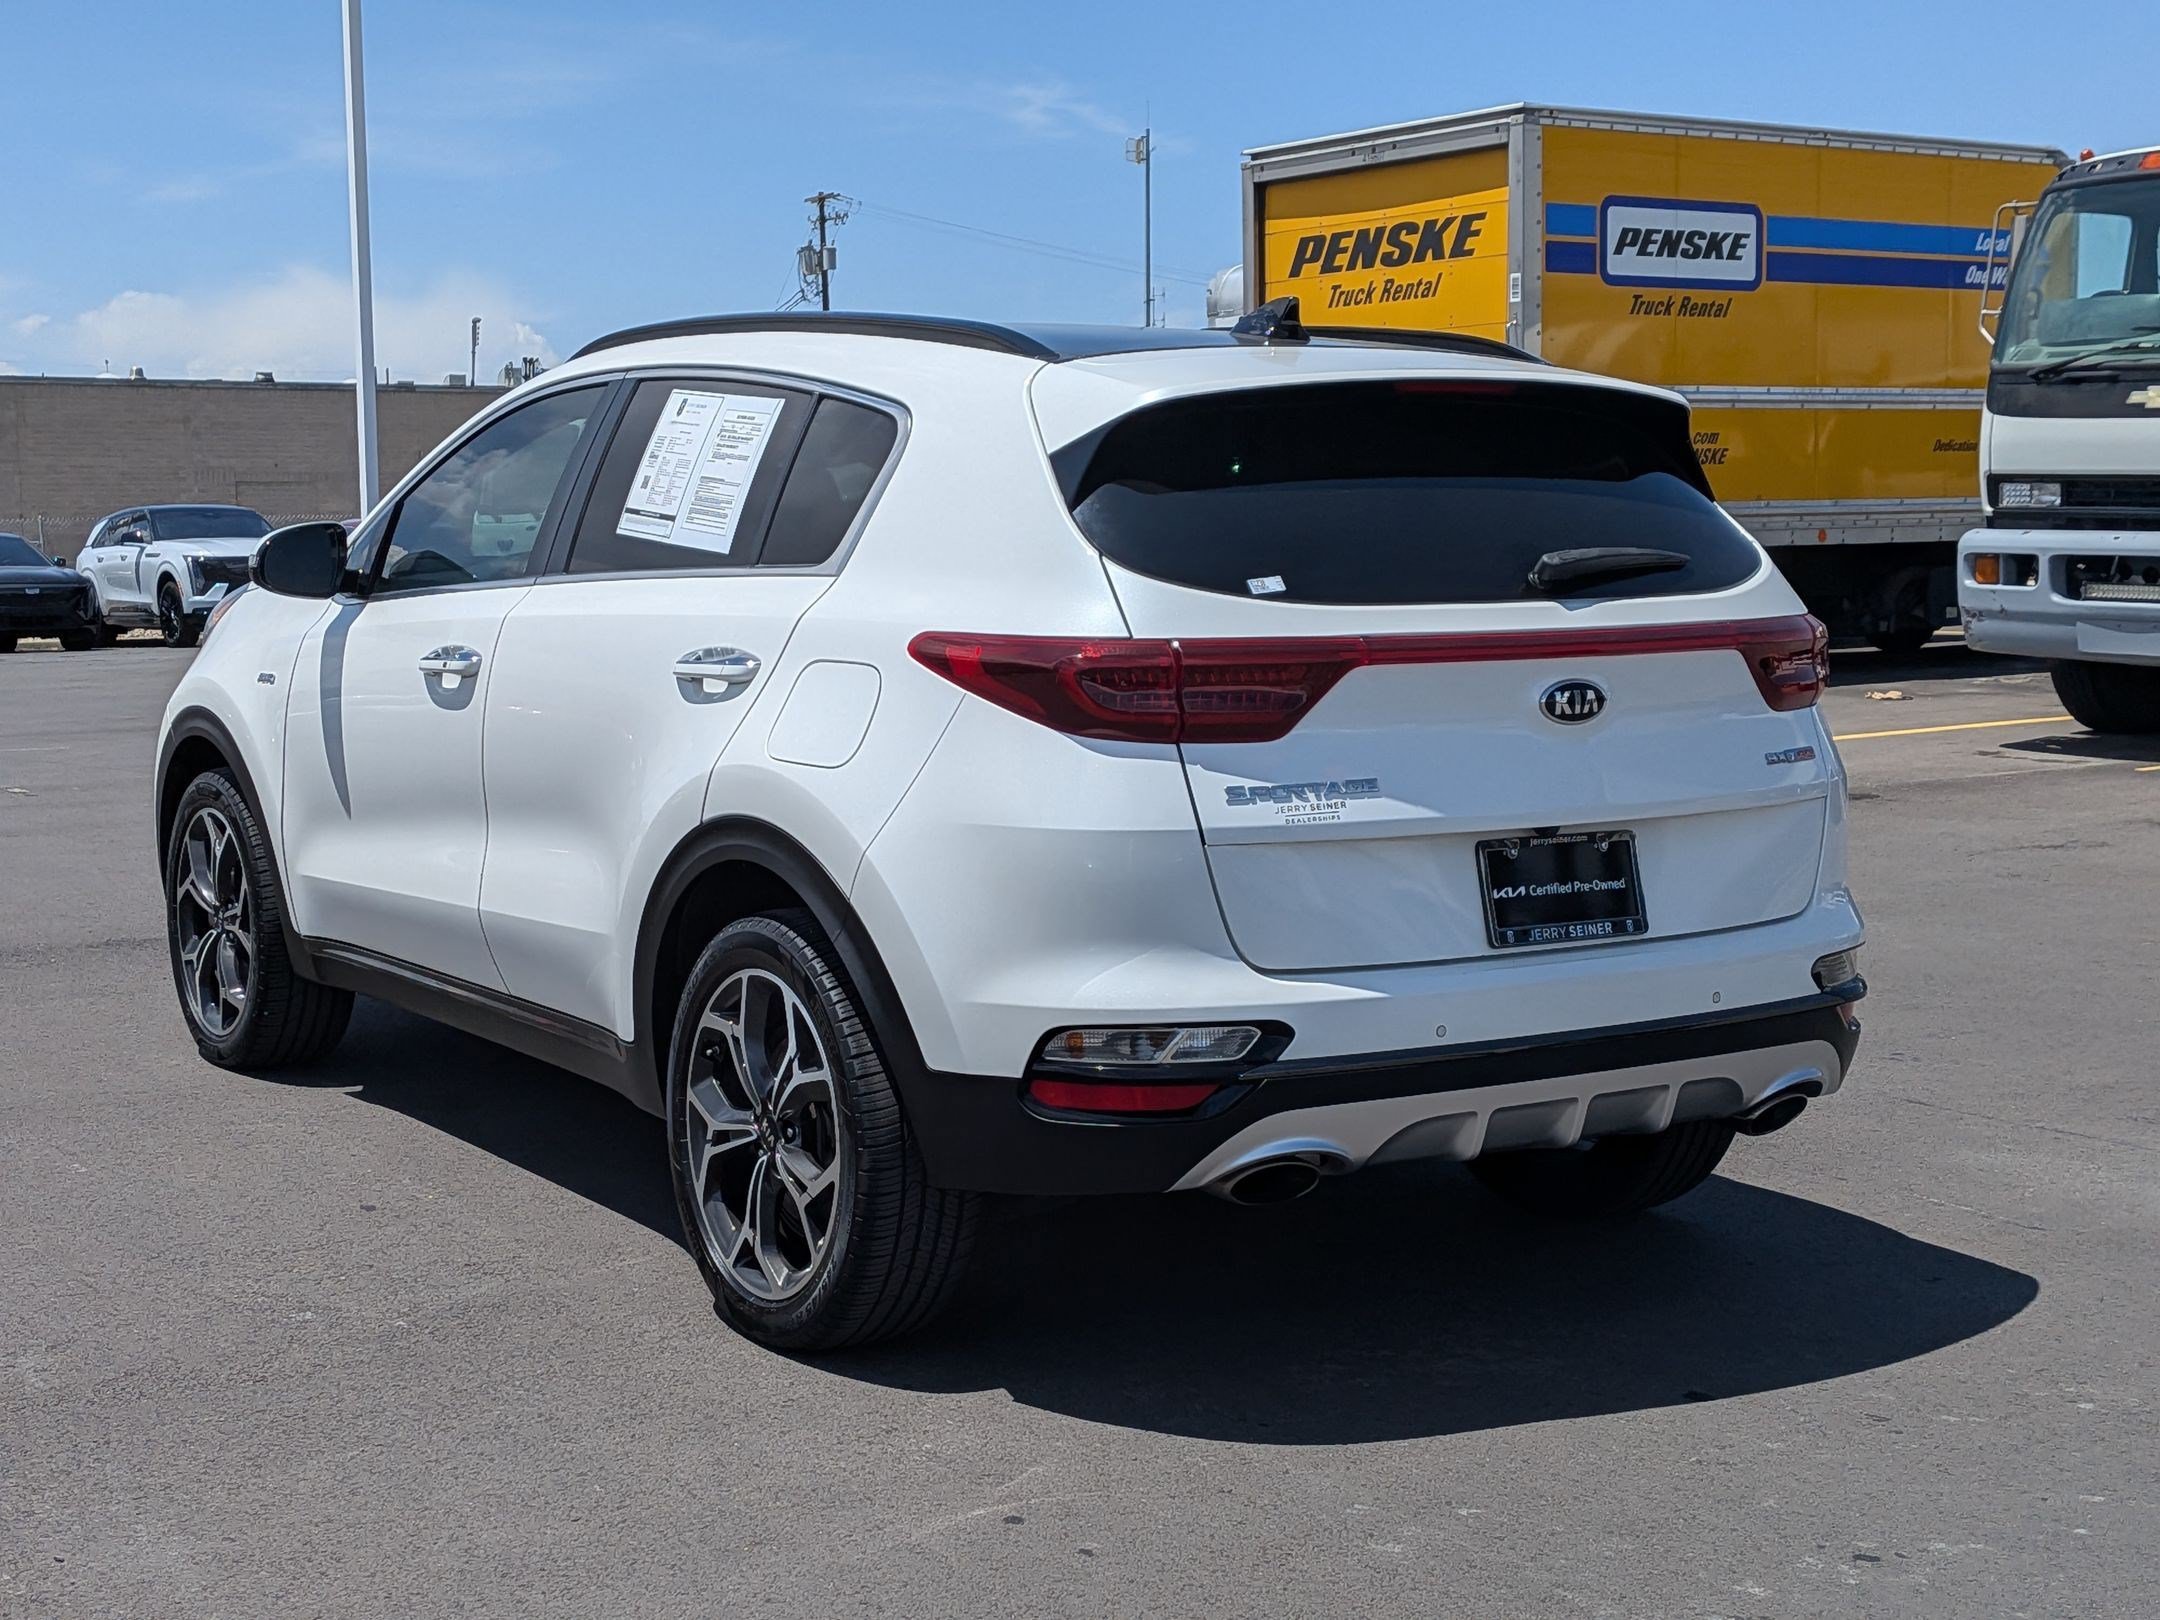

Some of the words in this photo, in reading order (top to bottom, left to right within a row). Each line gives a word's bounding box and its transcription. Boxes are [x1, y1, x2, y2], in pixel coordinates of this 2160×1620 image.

[1288, 212, 1488, 279] PENSKE
[1613, 227, 1751, 261] PENSKE
[1975, 232, 2011, 252] Loal
[1328, 280, 1378, 309] Truck
[1379, 272, 1443, 304] Rental
[1629, 294, 1675, 315] Truck
[1677, 296, 1733, 319] Rental
[1554, 689, 1599, 715] KIA
[1225, 778, 1380, 804] SPORTAGE
[1275, 804, 1308, 815] JERRY
[1309, 800, 1347, 812] SEINER
[1285, 814, 1341, 825] DEALERSHIPS
[1529, 881, 1573, 897] Certified
[1574, 877, 1626, 893] Pre-Owned
[1528, 926, 1568, 943] JERRY
[1568, 921, 1614, 938] SEINER
